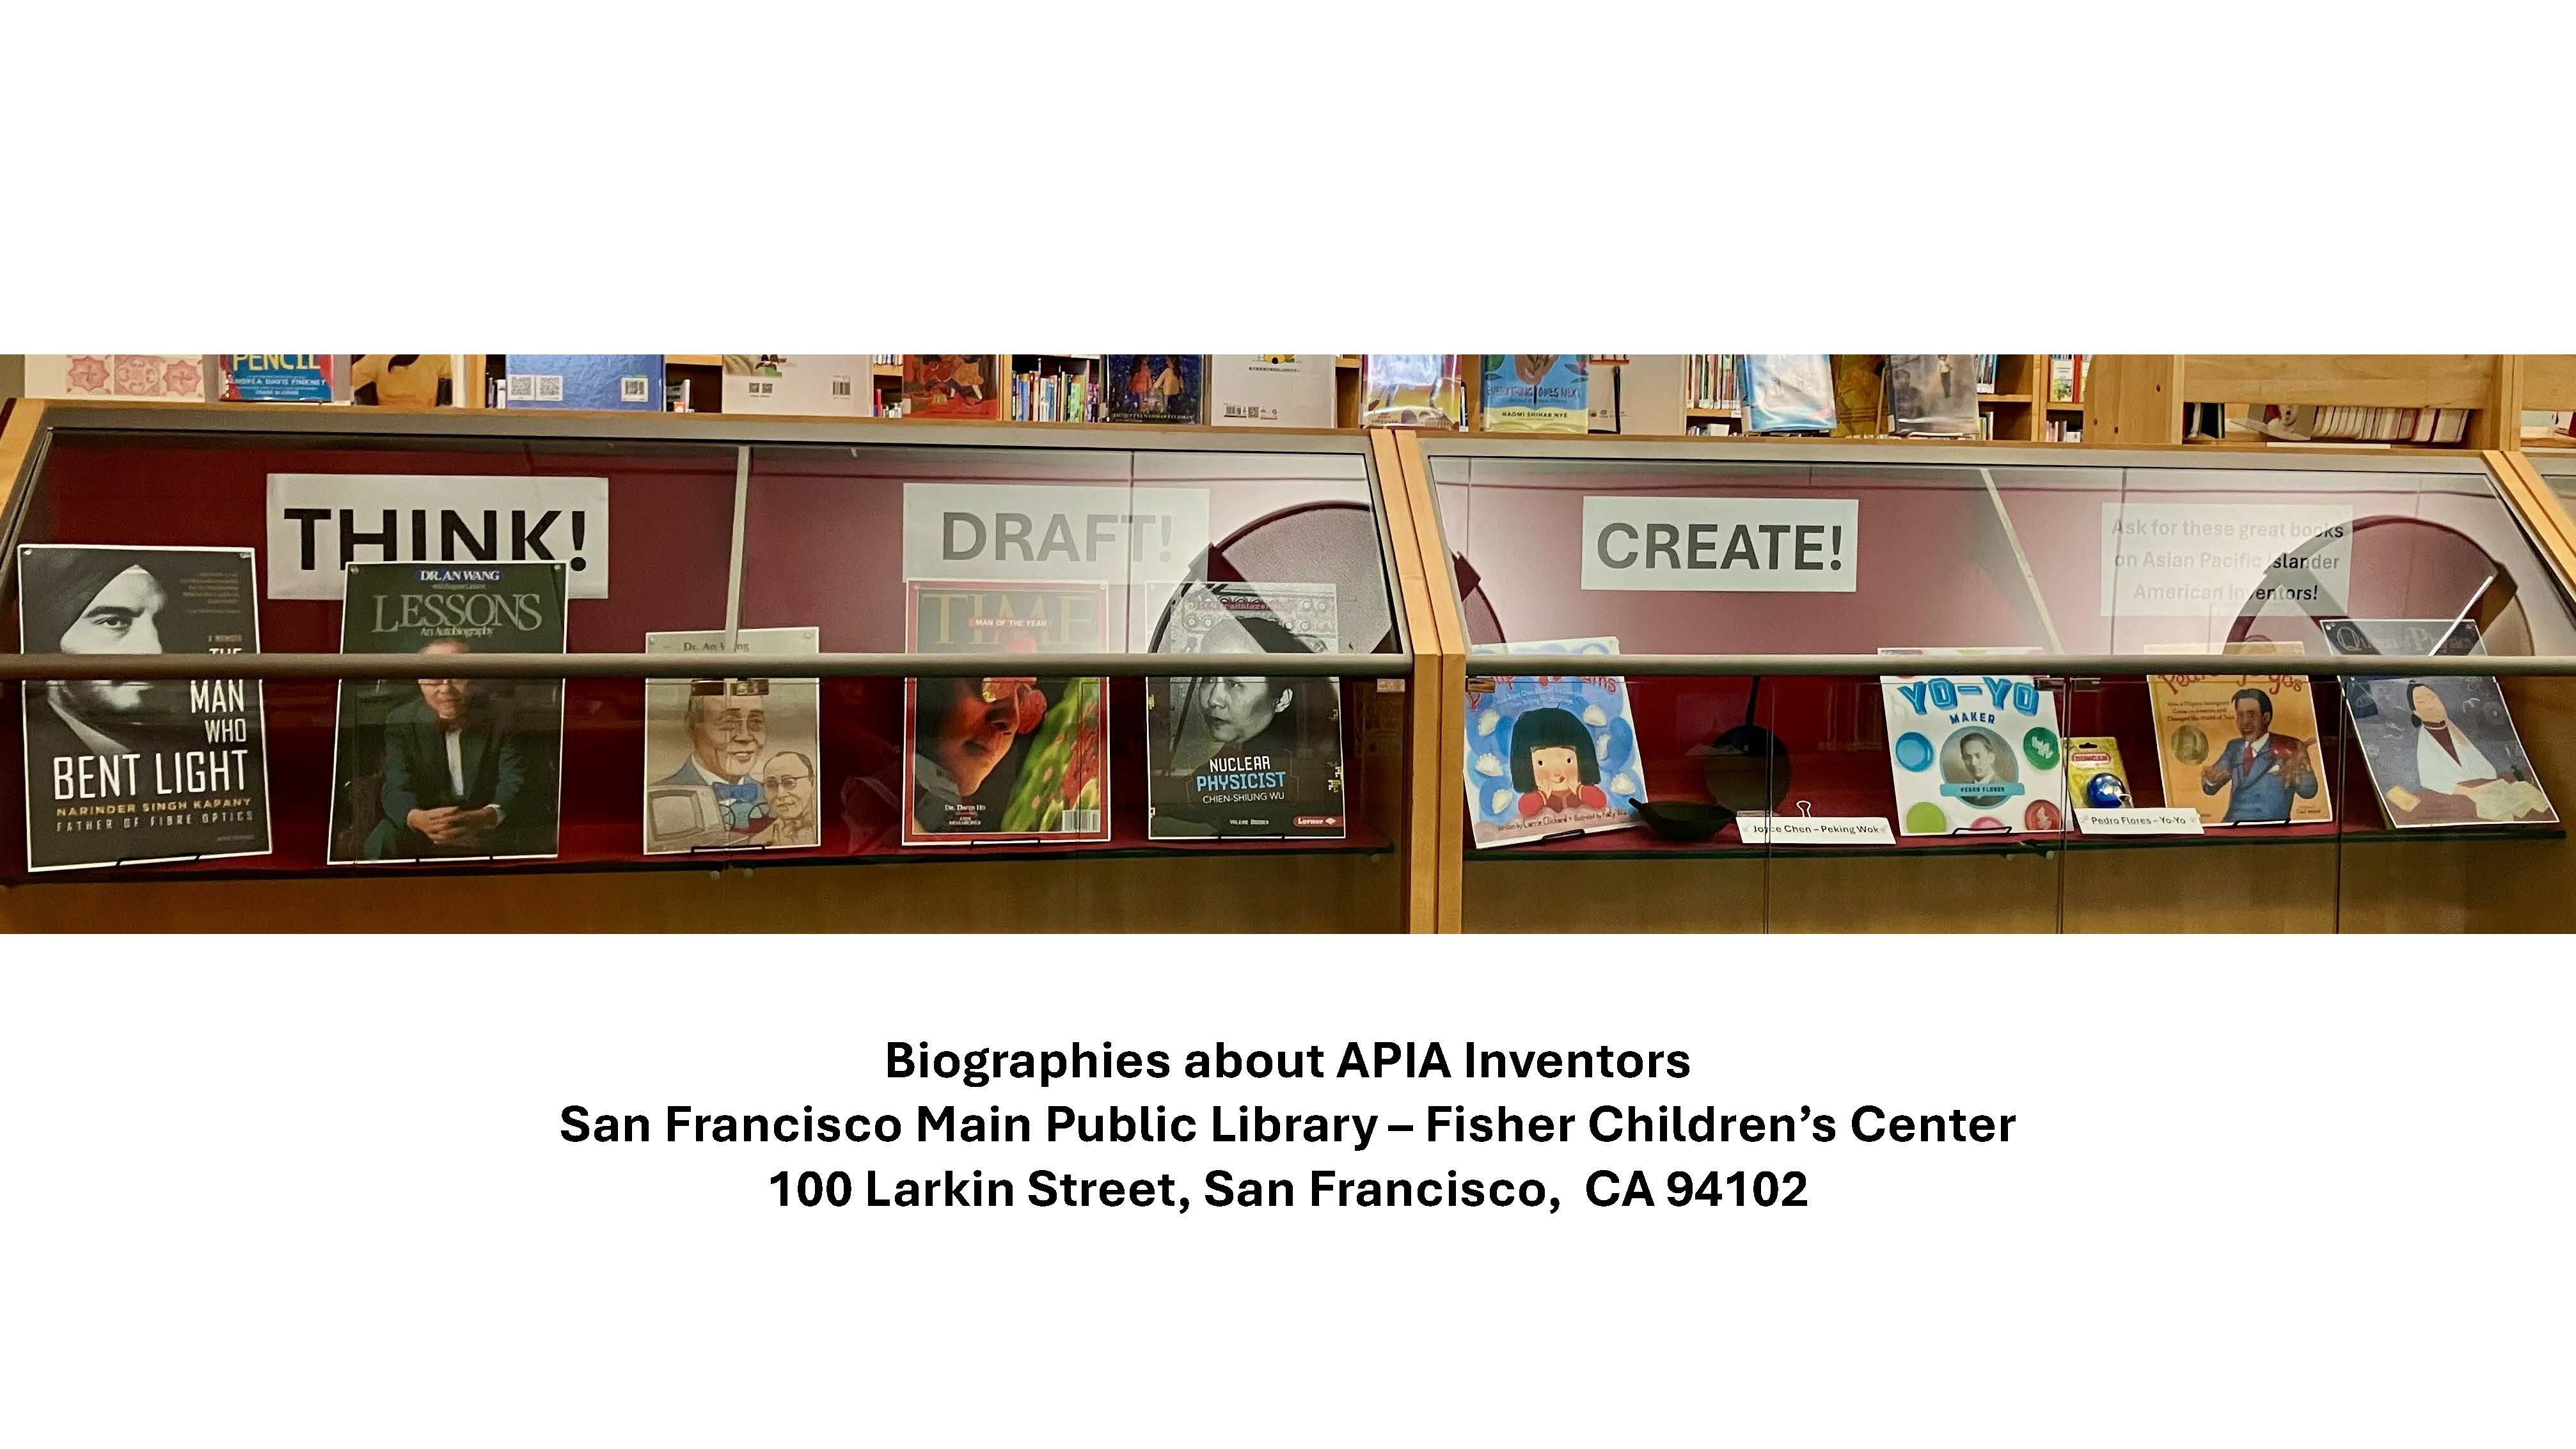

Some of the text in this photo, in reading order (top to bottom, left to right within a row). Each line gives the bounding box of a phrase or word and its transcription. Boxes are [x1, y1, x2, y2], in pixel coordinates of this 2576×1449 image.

[233, 354, 321, 371] PENCIL
[284, 508, 587, 572] THINK!
[942, 511, 1172, 563] DRAFT!
[2111, 519, 2344, 541] Ask for these great books
[1597, 521, 1842, 571] CREATE!
[2114, 555, 2138, 568] on
[2142, 552, 2195, 568] Asian
[2200, 552, 2261, 568] Pacific
[464, 570, 501, 581] WANG
[2133, 583, 2318, 601] American Inventors!
[371, 594, 543, 633] LESSONS
[921, 594, 1099, 645] TIME
[702, 642, 717, 651] An
[191, 679, 245, 714] MAN
[1897, 676, 2040, 717] YO-YO
[1949, 711, 1996, 725] MAKER
[205, 718, 247, 744] WHO
[53, 749, 248, 800] BENT LIGHT
[1209, 756, 1271, 773] NUCLEAR
[1196, 771, 1286, 792] PHYSICIST
[56, 798, 252, 817] NARINDER SINGH KAPANY
[1203, 791, 1285, 804] CHIEN-SHIUNG WU
[56, 819, 113, 832] FATHER
[123, 817, 139, 829] OF
[202, 811, 253, 824] OPTICS
[1753, 825, 1782, 834] Joyce
[1784, 825, 1812, 834] Chen
[1821, 825, 1856, 835] Peking
[1856, 825, 1879, 834] Wok
